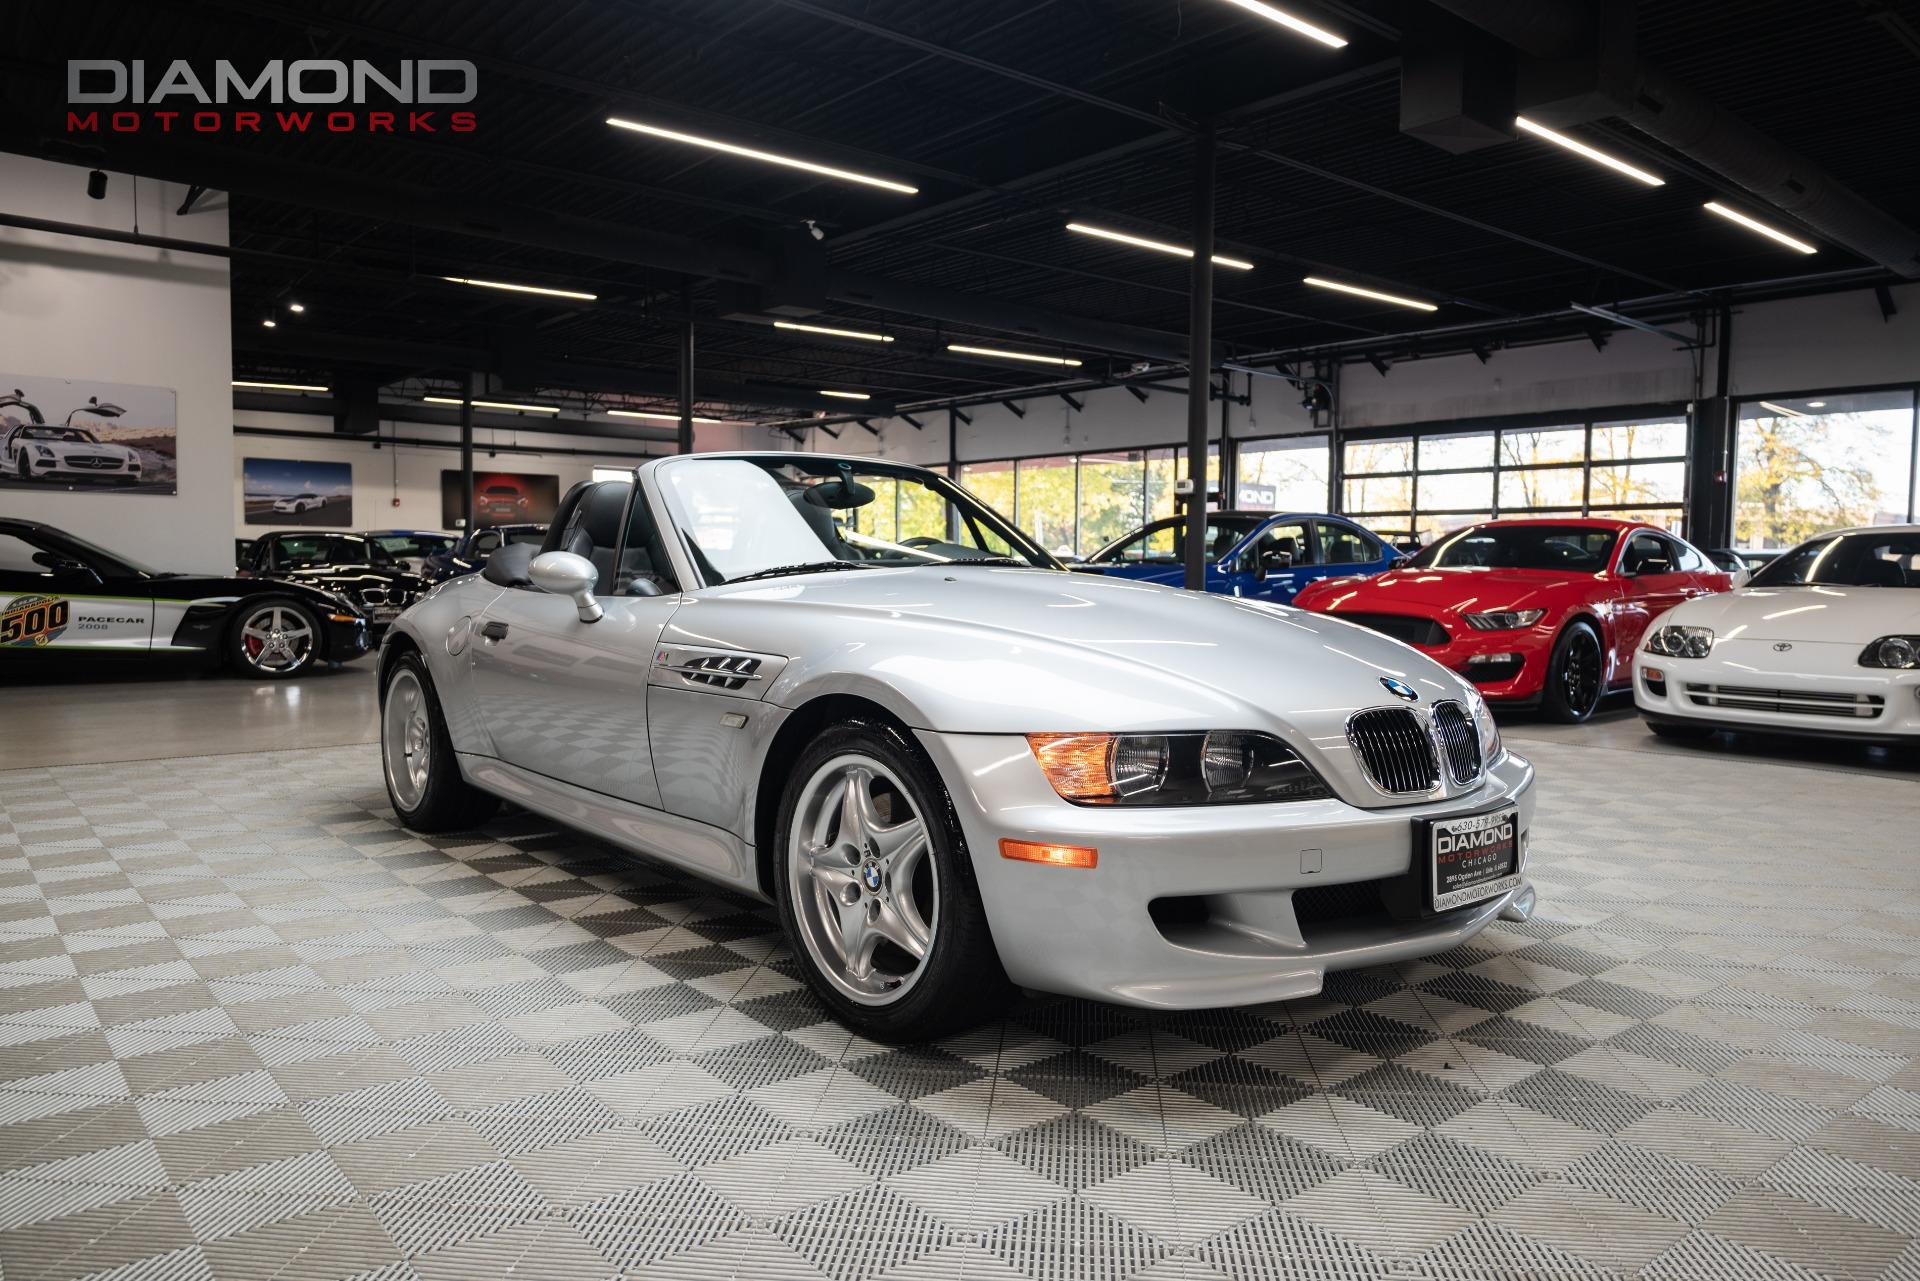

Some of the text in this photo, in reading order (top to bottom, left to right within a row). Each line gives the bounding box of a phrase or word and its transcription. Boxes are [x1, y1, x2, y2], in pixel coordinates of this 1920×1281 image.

[1, 601, 69, 643] 500
[78, 616, 145, 624] PACECAR
[1438, 823, 1513, 854] DIAMOND
[1438, 841, 1512, 864] MOTORWORKS
[1462, 853, 1497, 869] CHICAGO
